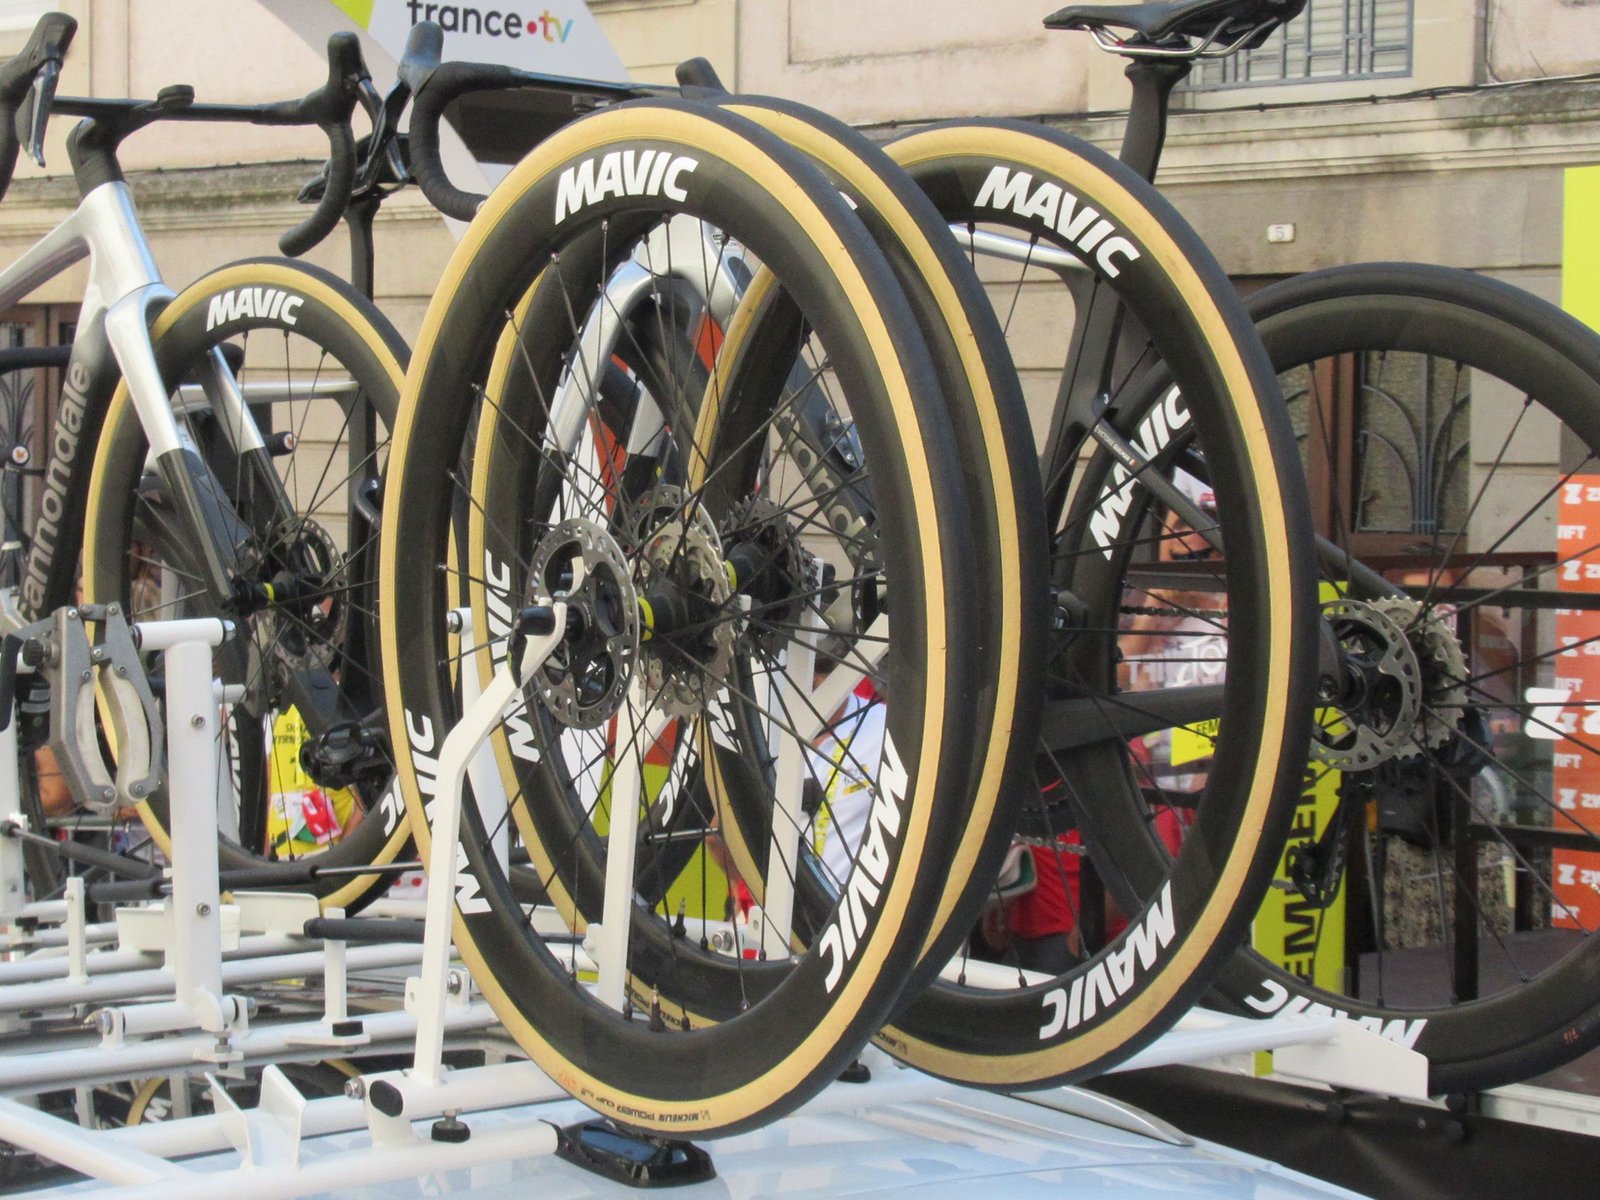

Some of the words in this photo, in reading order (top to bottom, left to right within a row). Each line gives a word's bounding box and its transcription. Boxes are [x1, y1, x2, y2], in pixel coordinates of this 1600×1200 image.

[555, 150, 699, 225] MAVIC
[974, 166, 1141, 279] MAVIC
[207, 288, 305, 332] MAVIC
[820, 728, 909, 994] MAVIC
[1039, 880, 1176, 1040] MAVIC
[617, 1105, 656, 1121] POWER
[658, 1113, 700, 1123] MICHELIN
